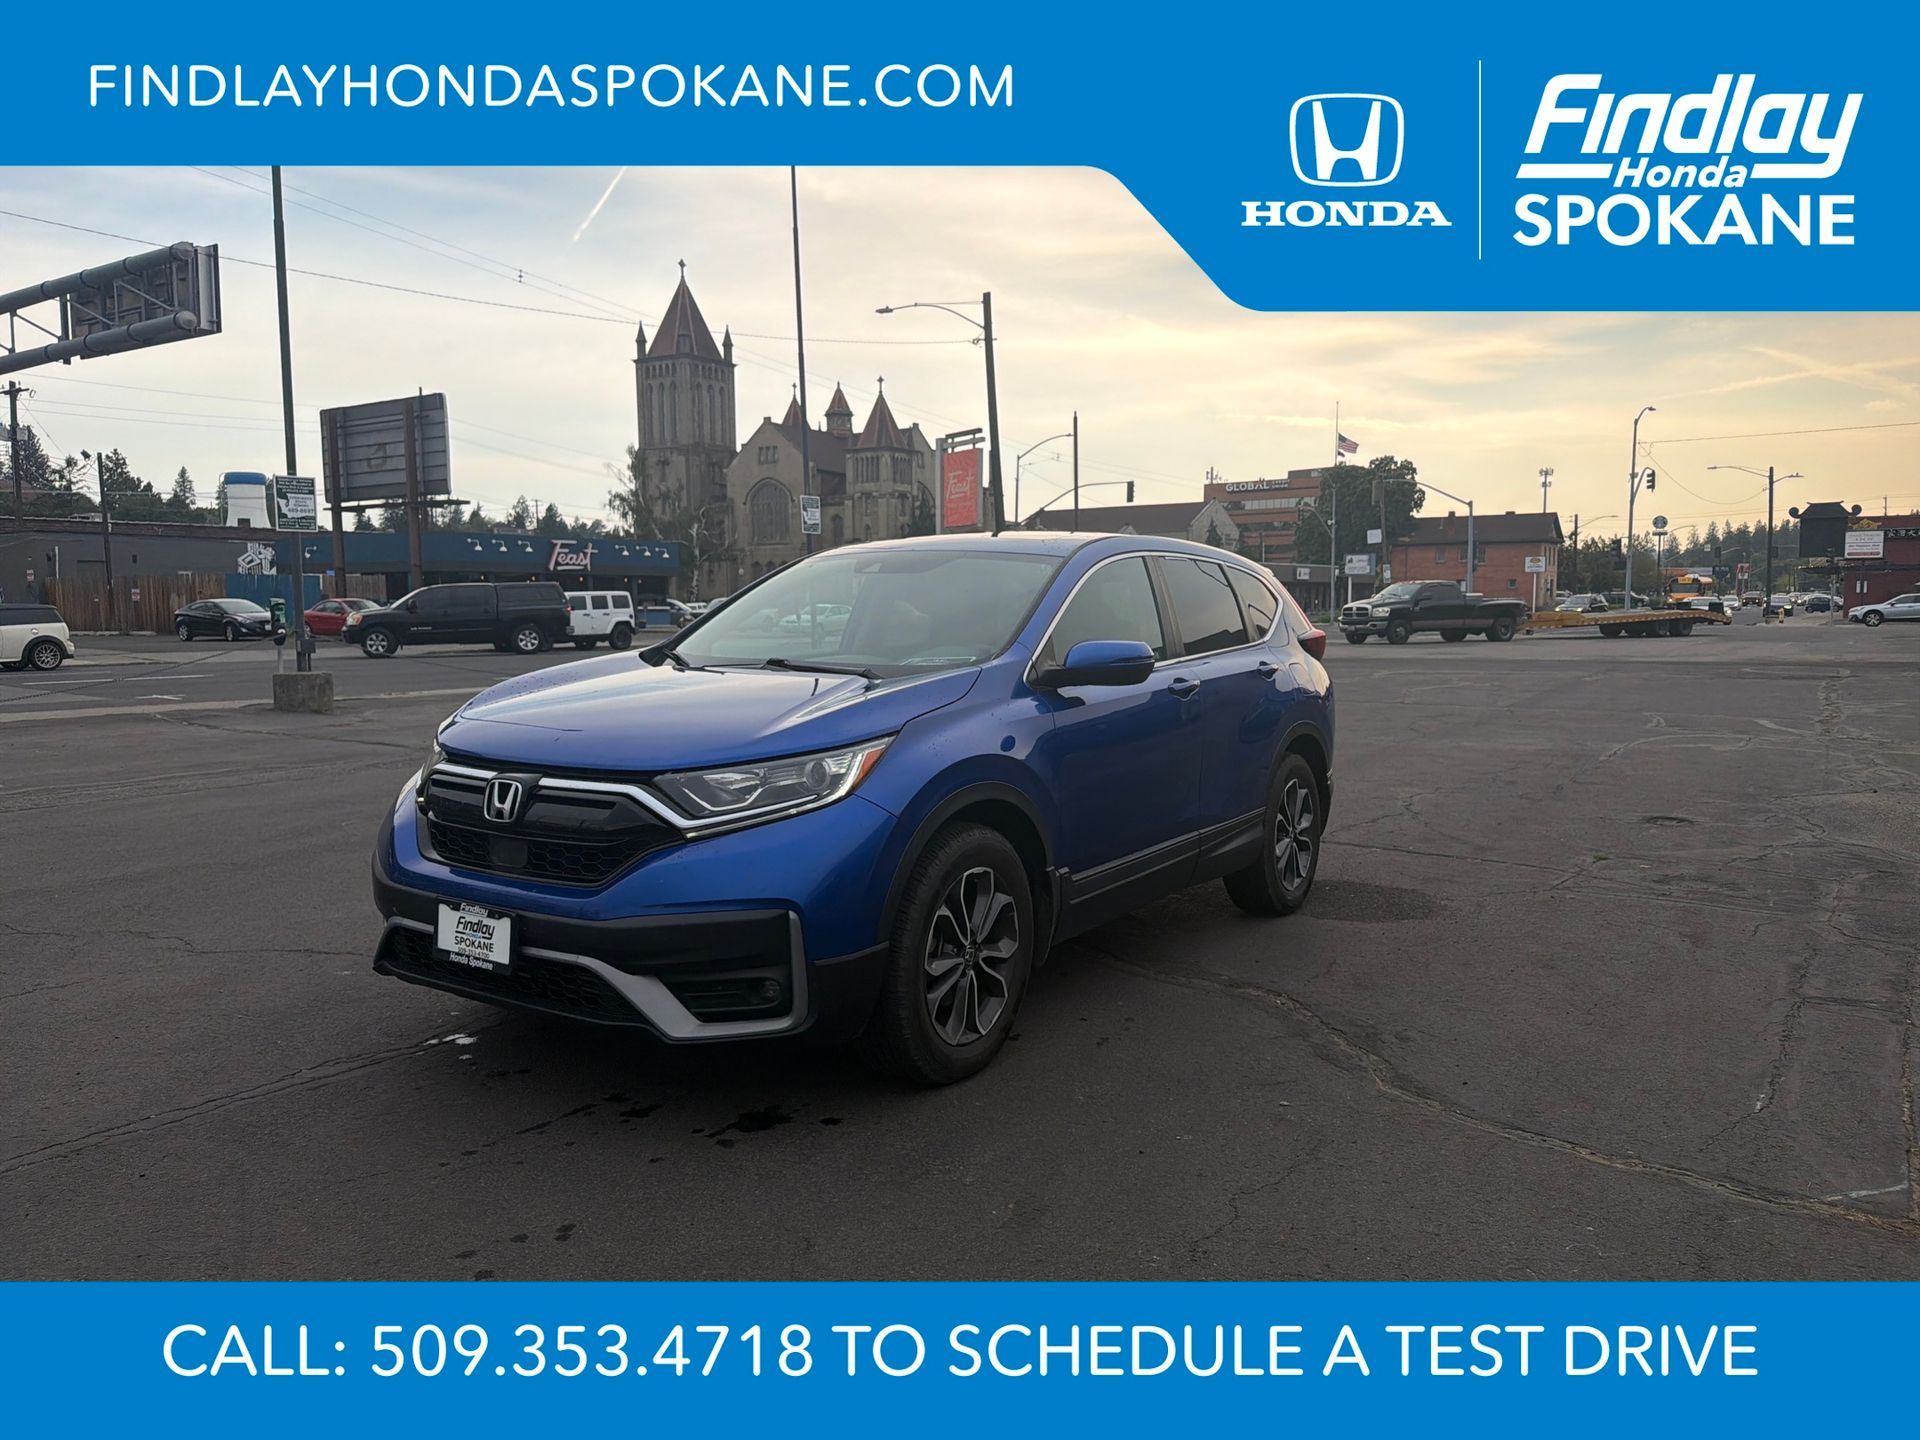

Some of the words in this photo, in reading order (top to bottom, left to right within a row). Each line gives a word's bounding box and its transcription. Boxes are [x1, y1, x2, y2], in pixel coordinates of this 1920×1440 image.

[1225, 481, 1269, 492] GLOBAL
[549, 539, 598, 571] Feast
[460, 902, 488, 917] Findlay
[455, 915, 496, 940] Findlay
[454, 935, 495, 953] SPOKANE
[449, 951, 469, 965] Honda
[469, 955, 494, 971] Spokane
